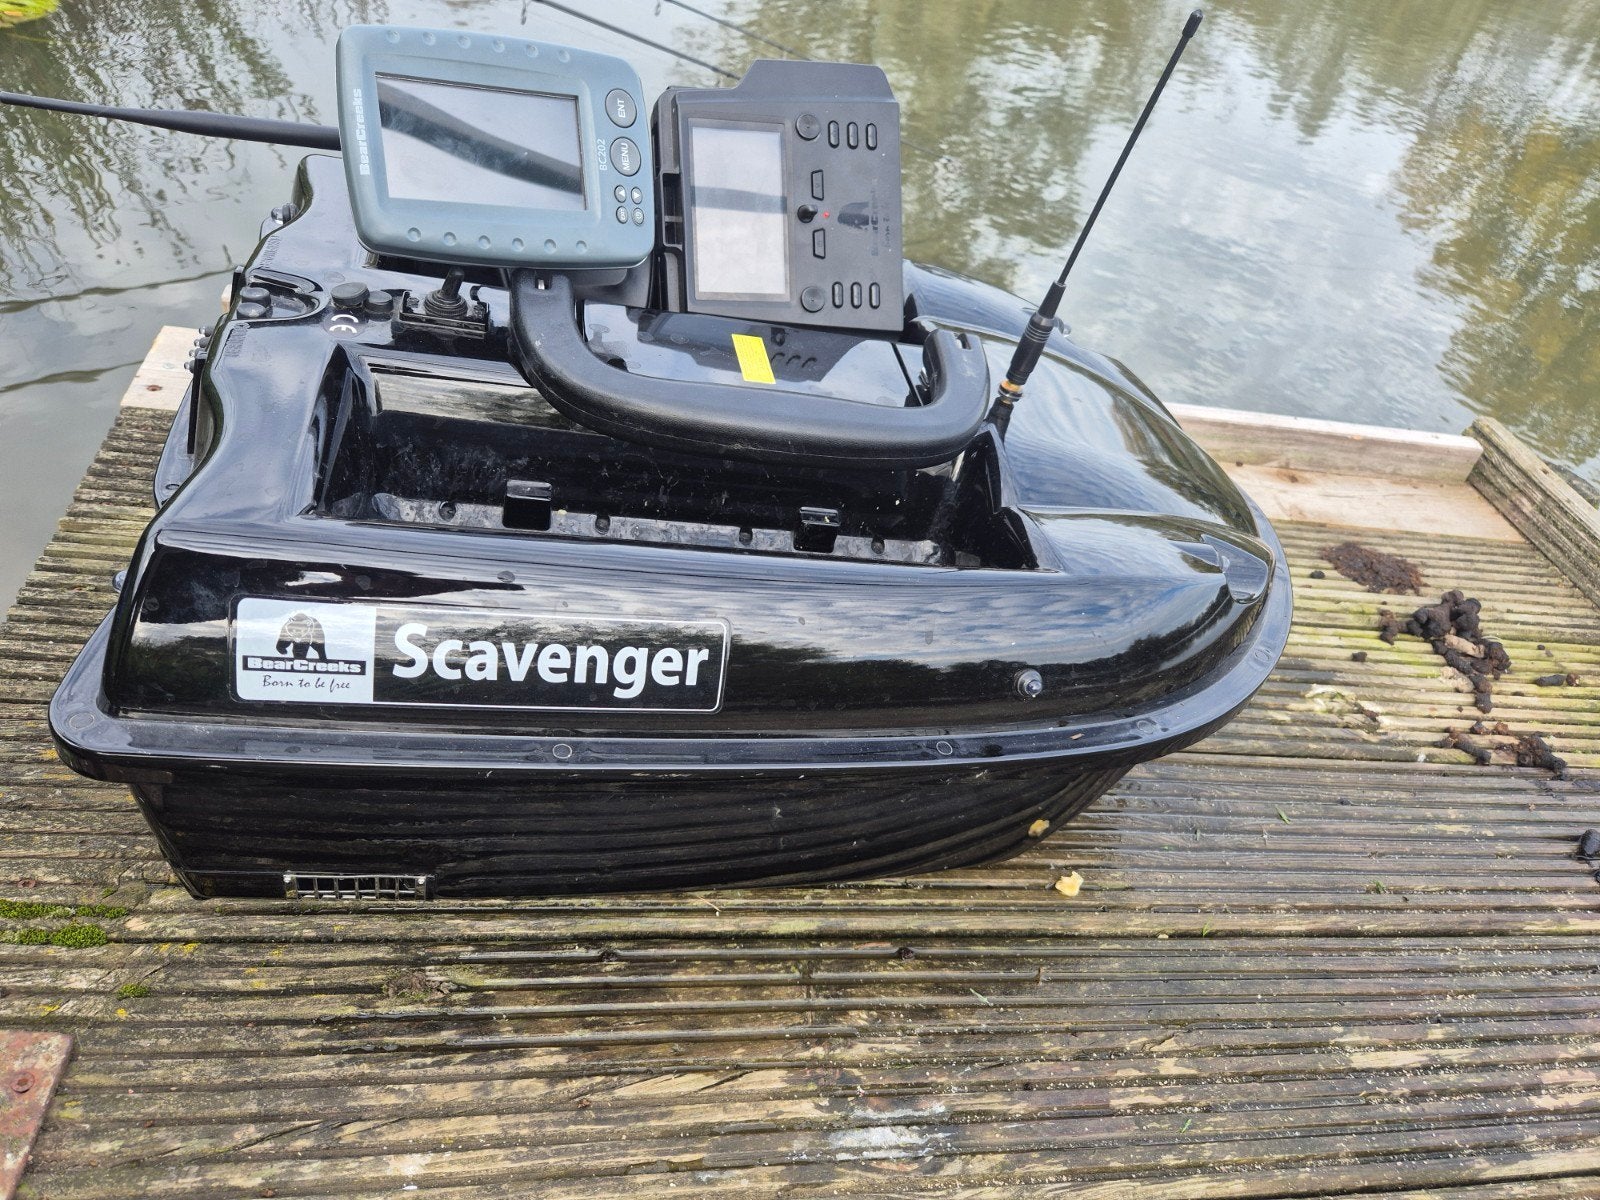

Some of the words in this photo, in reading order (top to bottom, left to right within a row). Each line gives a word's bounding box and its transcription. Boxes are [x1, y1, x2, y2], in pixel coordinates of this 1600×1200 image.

[617, 98, 626, 118] ENT
[352, 88, 370, 175] BearCreeks
[598, 139, 608, 171] BC202
[621, 142, 631, 171] MENU
[247, 657, 362, 673] BearCreeks
[392, 622, 709, 699] Scavenger
[262, 674, 294, 687] Born
[298, 677, 311, 688] to
[314, 677, 325, 689] be
[329, 678, 351, 693] free
